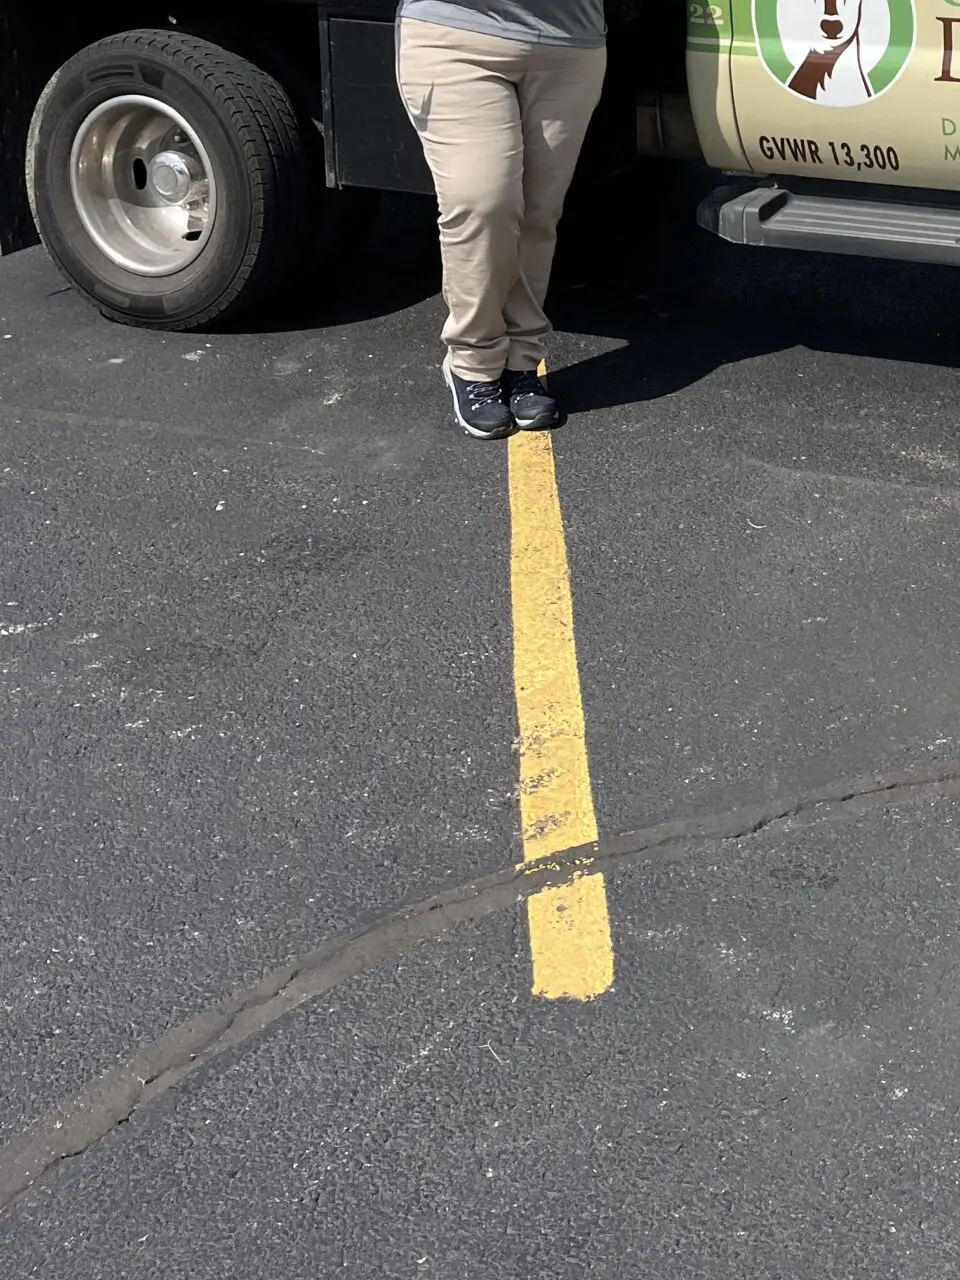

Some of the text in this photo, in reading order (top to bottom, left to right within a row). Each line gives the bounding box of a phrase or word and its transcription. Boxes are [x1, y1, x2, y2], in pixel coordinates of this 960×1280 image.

[689, 3, 724, 25] 22
[758, 135, 900, 171] GVWR 13,300
